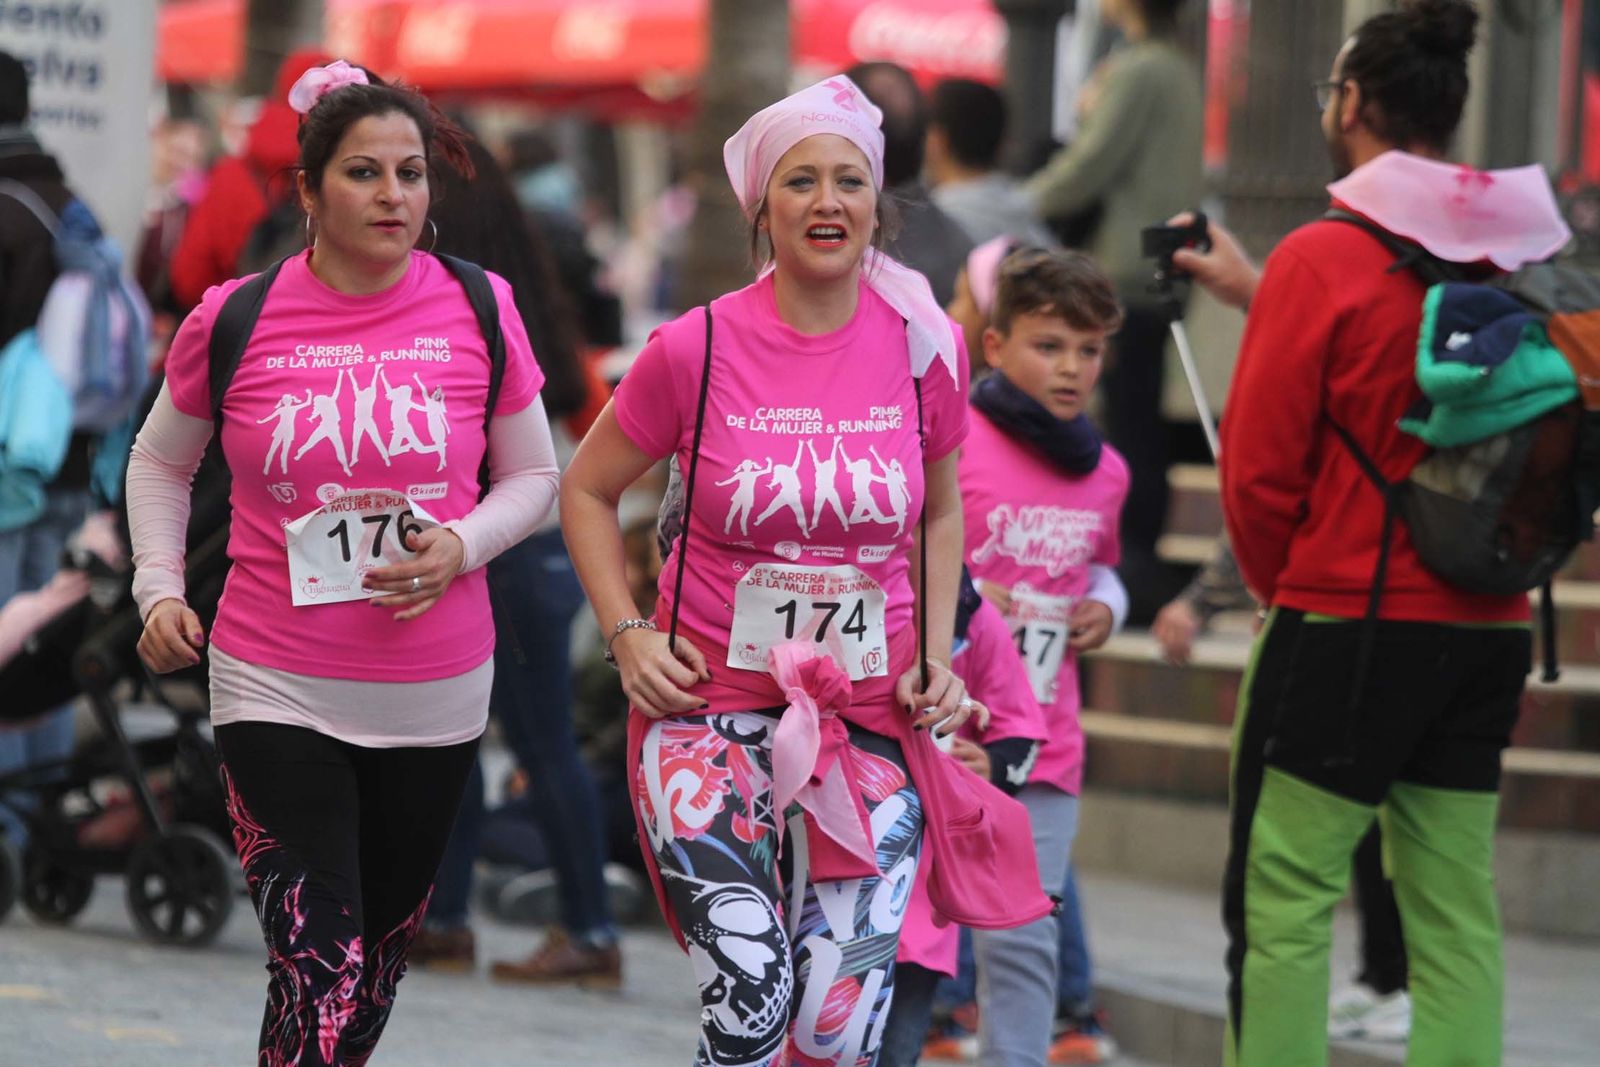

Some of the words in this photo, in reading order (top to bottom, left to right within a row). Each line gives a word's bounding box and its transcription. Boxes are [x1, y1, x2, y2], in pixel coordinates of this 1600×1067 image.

[295, 343, 364, 358] CARRERA
[414, 337, 450, 349] PINK
[266, 357, 286, 369] DE
[288, 356, 308, 369] LA
[311, 355, 364, 369] MUJER
[367, 355, 377, 363] &
[380, 349, 452, 363] RUNNING
[755, 407, 823, 421] CARRERA
[726, 415, 747, 429] DE
[749, 420, 768, 433] LA
[771, 421, 823, 434] MUJER
[825, 424, 836, 434] &
[838, 416, 903, 433] RUNNING
[331, 500, 372, 513] MUJER
[376, 500, 383, 509] &
[327, 509, 423, 563] 176
[770, 570, 826, 585] CARRERA
[746, 577, 762, 587] DE
[766, 579, 780, 589] LA
[783, 583, 825, 596] MUJER
[828, 587, 835, 595] &
[775, 598, 867, 644] 174
